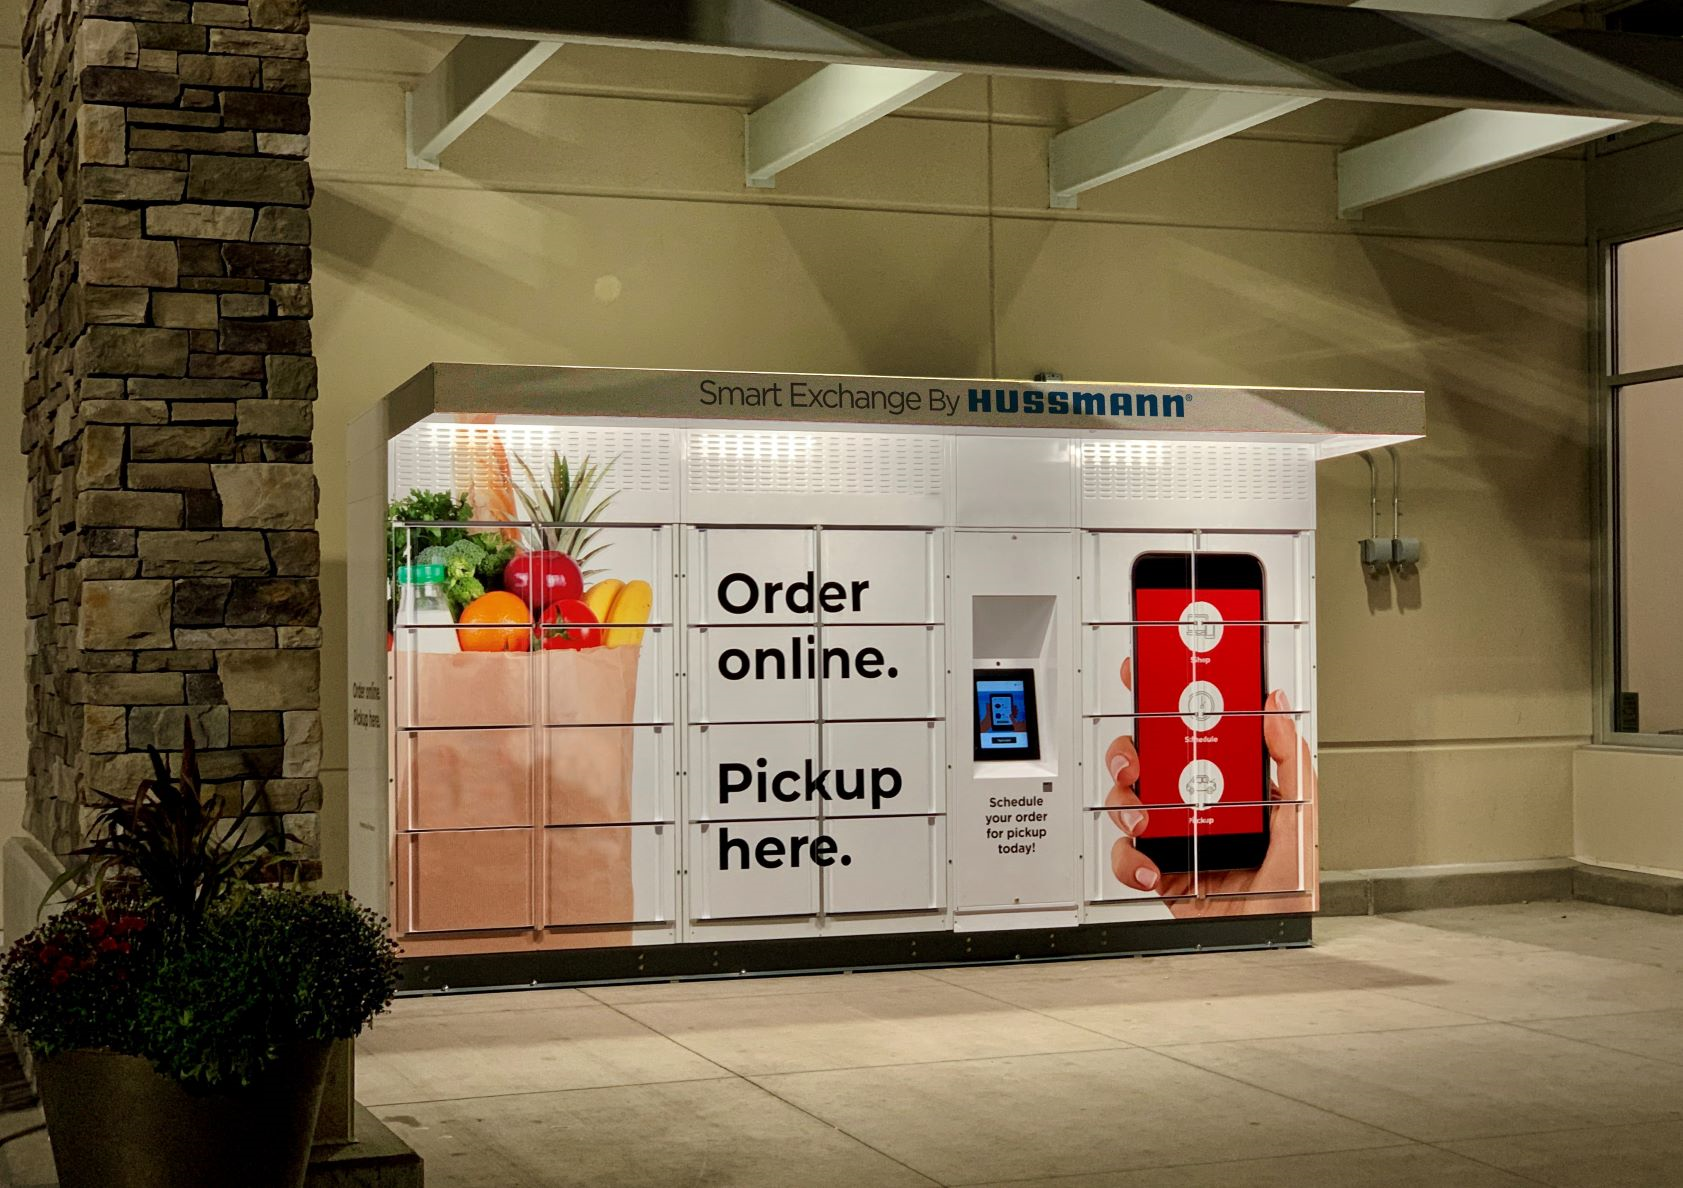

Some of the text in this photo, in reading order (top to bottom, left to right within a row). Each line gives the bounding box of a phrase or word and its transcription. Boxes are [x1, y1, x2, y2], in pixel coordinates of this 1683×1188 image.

[700, 379, 782, 407] Smart
[790, 382, 922, 415] Exchange
[929, 388, 960, 416] By
[717, 571, 869, 614] Order
[718, 634, 898, 681] online.
[718, 757, 902, 809] Pickup
[989, 795, 1044, 808] Schedule
[985, 811, 1048, 826] your order
[986, 827, 1047, 840] for pickup
[718, 827, 852, 870] here.
[998, 842, 1036, 856] today!
